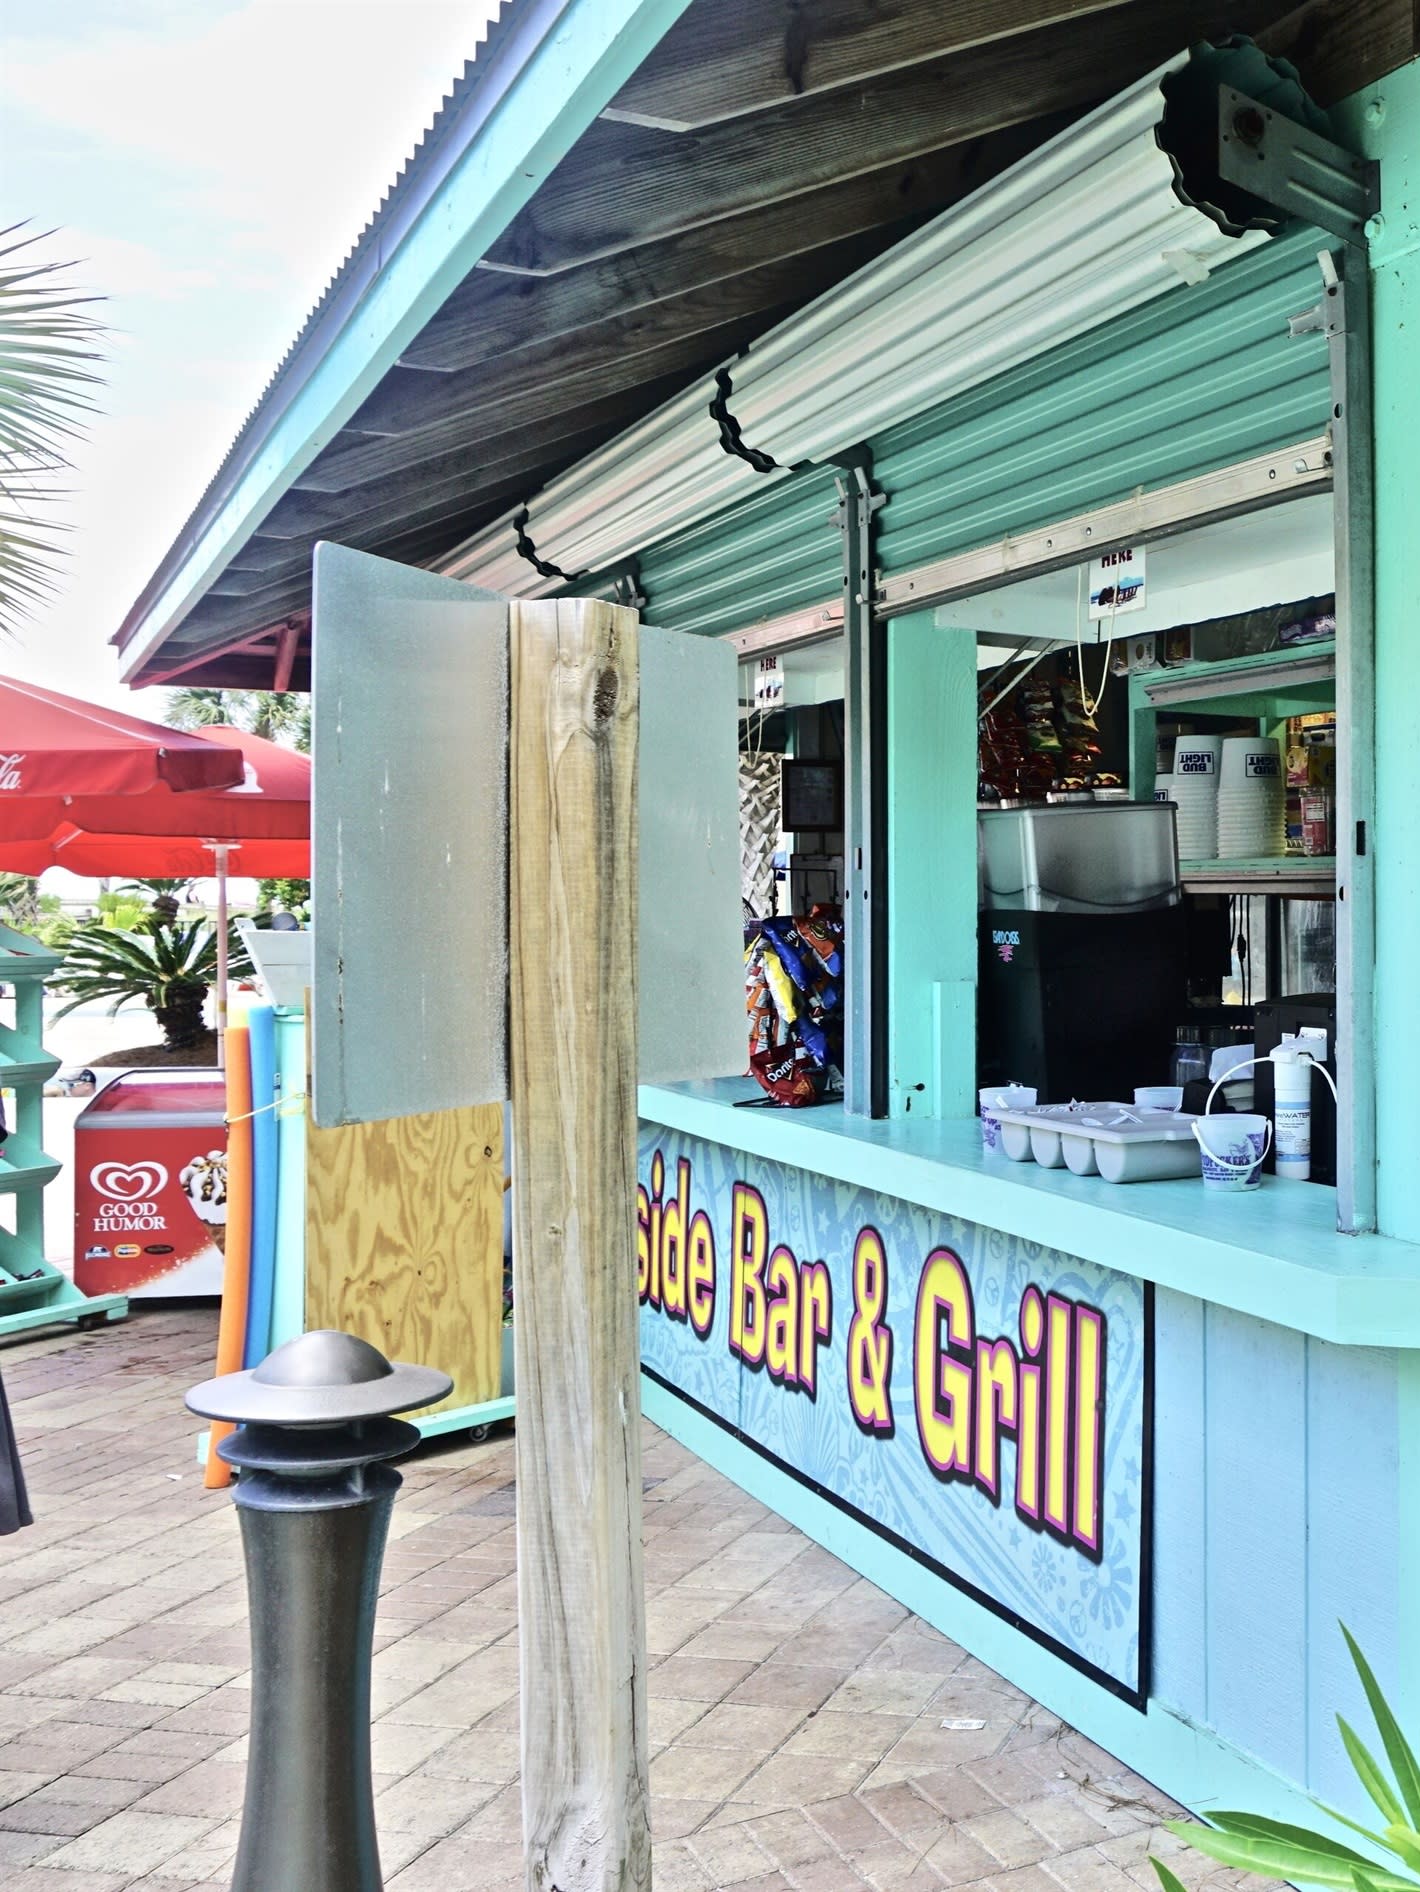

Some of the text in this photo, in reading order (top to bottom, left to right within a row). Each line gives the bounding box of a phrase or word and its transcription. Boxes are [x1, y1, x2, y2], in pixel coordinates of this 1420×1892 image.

[1180, 753, 1212, 763] LIGHT
[1182, 763, 1207, 772] BUD
[99, 1202, 158, 1217] GOOD
[93, 1216, 168, 1232] HUMOR
[729, 1181, 832, 1402] Bar
[848, 1224, 895, 1440] &
[913, 1244, 1107, 1562] Grill
